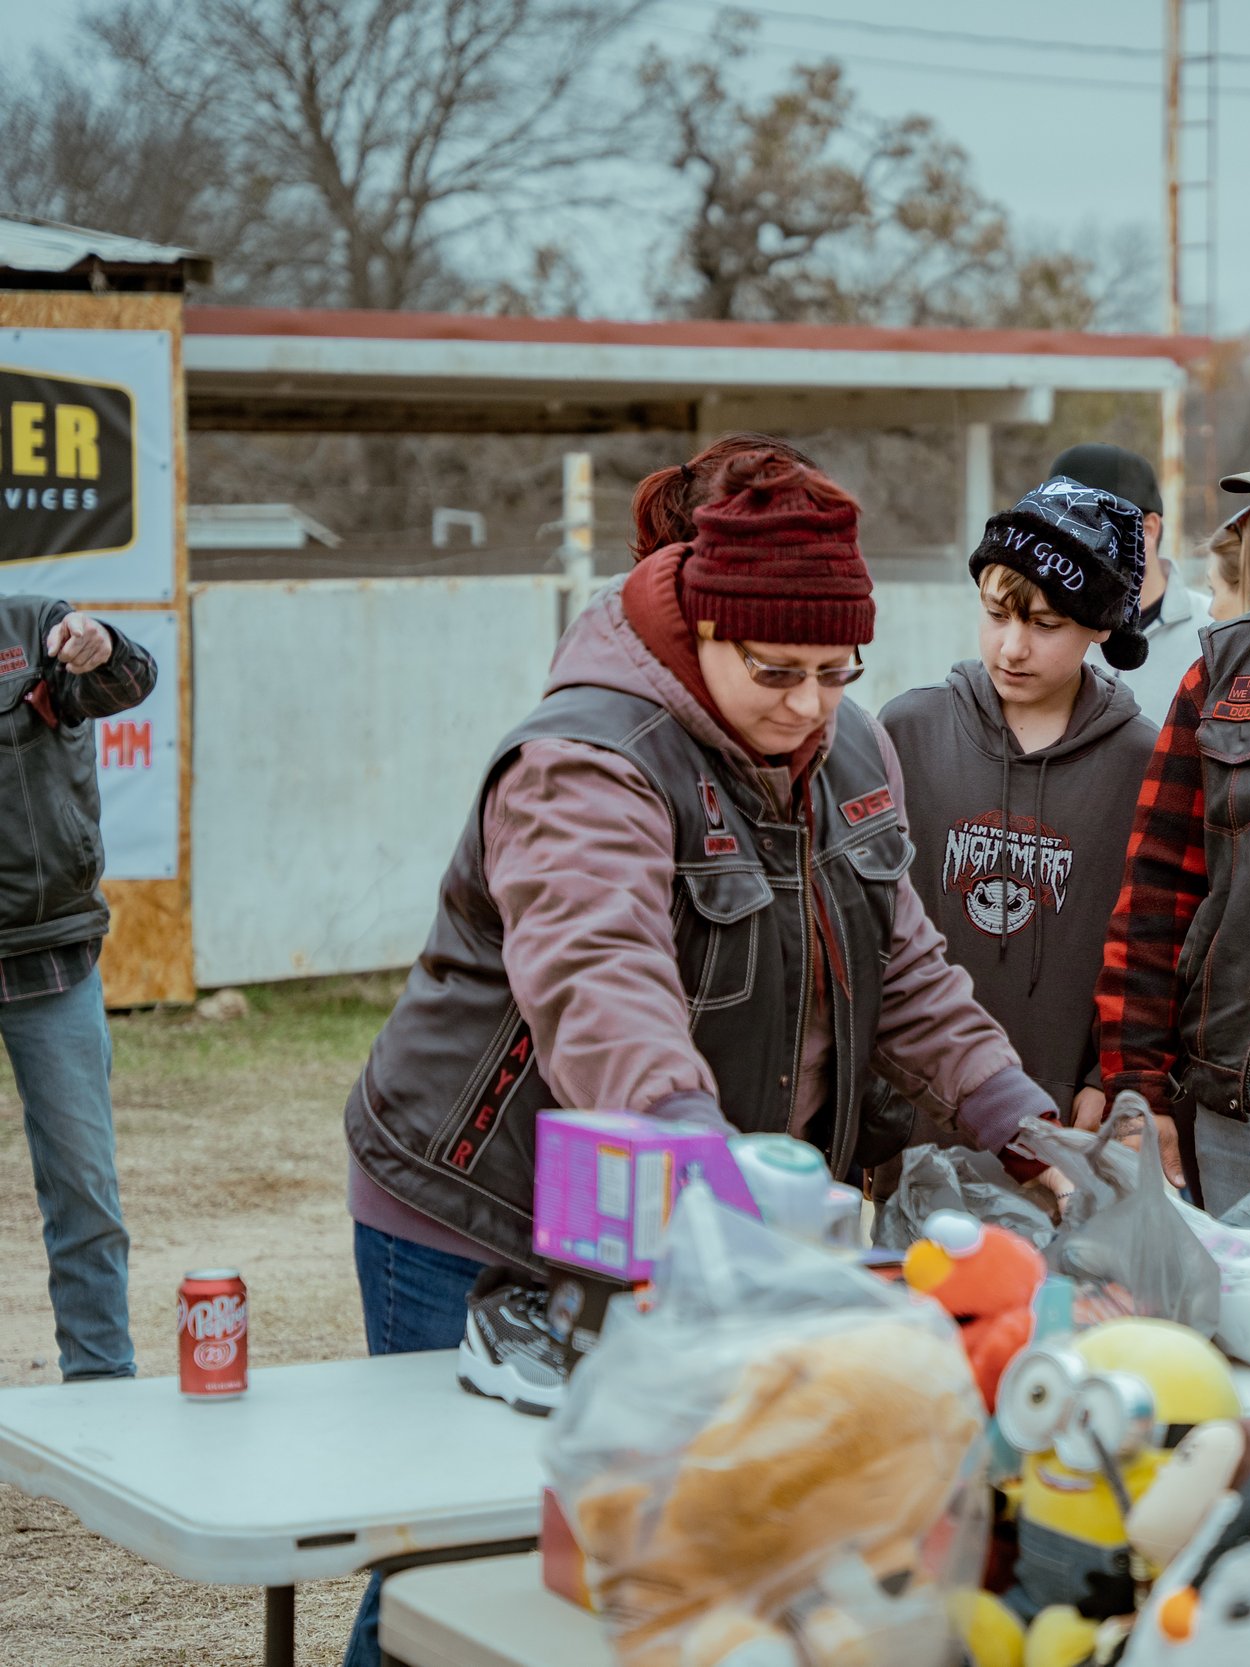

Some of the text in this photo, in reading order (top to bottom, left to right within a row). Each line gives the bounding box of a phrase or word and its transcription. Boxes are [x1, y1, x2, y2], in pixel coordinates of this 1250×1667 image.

[0, 401, 100, 480] ER
[1033, 542, 1084, 591] GOOD
[1232, 689, 1248, 698] WE
[969, 824, 988, 836] AM
[989, 827, 1019, 842] YOUR
[1021, 833, 1063, 848] WORST
[942, 828, 1074, 915] NIGHMARE
